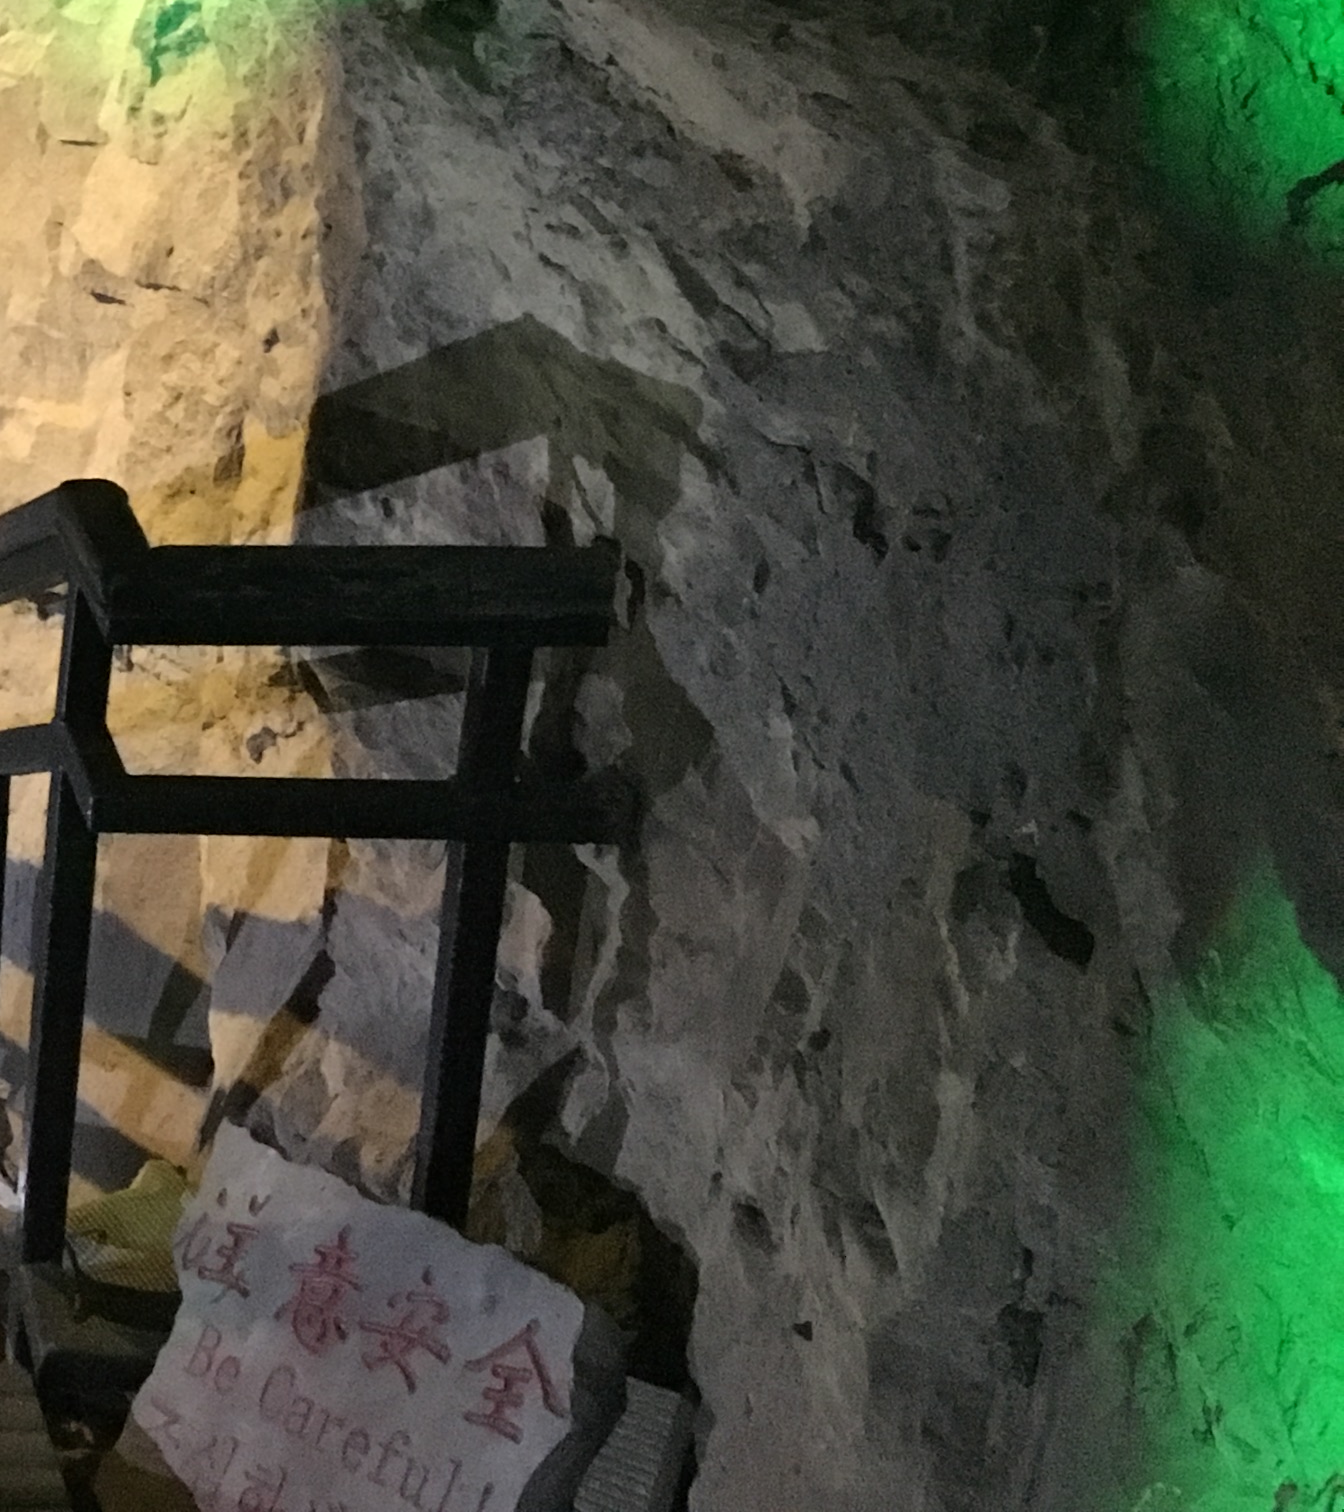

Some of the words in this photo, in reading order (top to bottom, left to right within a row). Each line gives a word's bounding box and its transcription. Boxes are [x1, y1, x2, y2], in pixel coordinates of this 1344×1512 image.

[178, 1189, 569, 1444] 注意安全
[184, 1325, 240, 1395] Be
